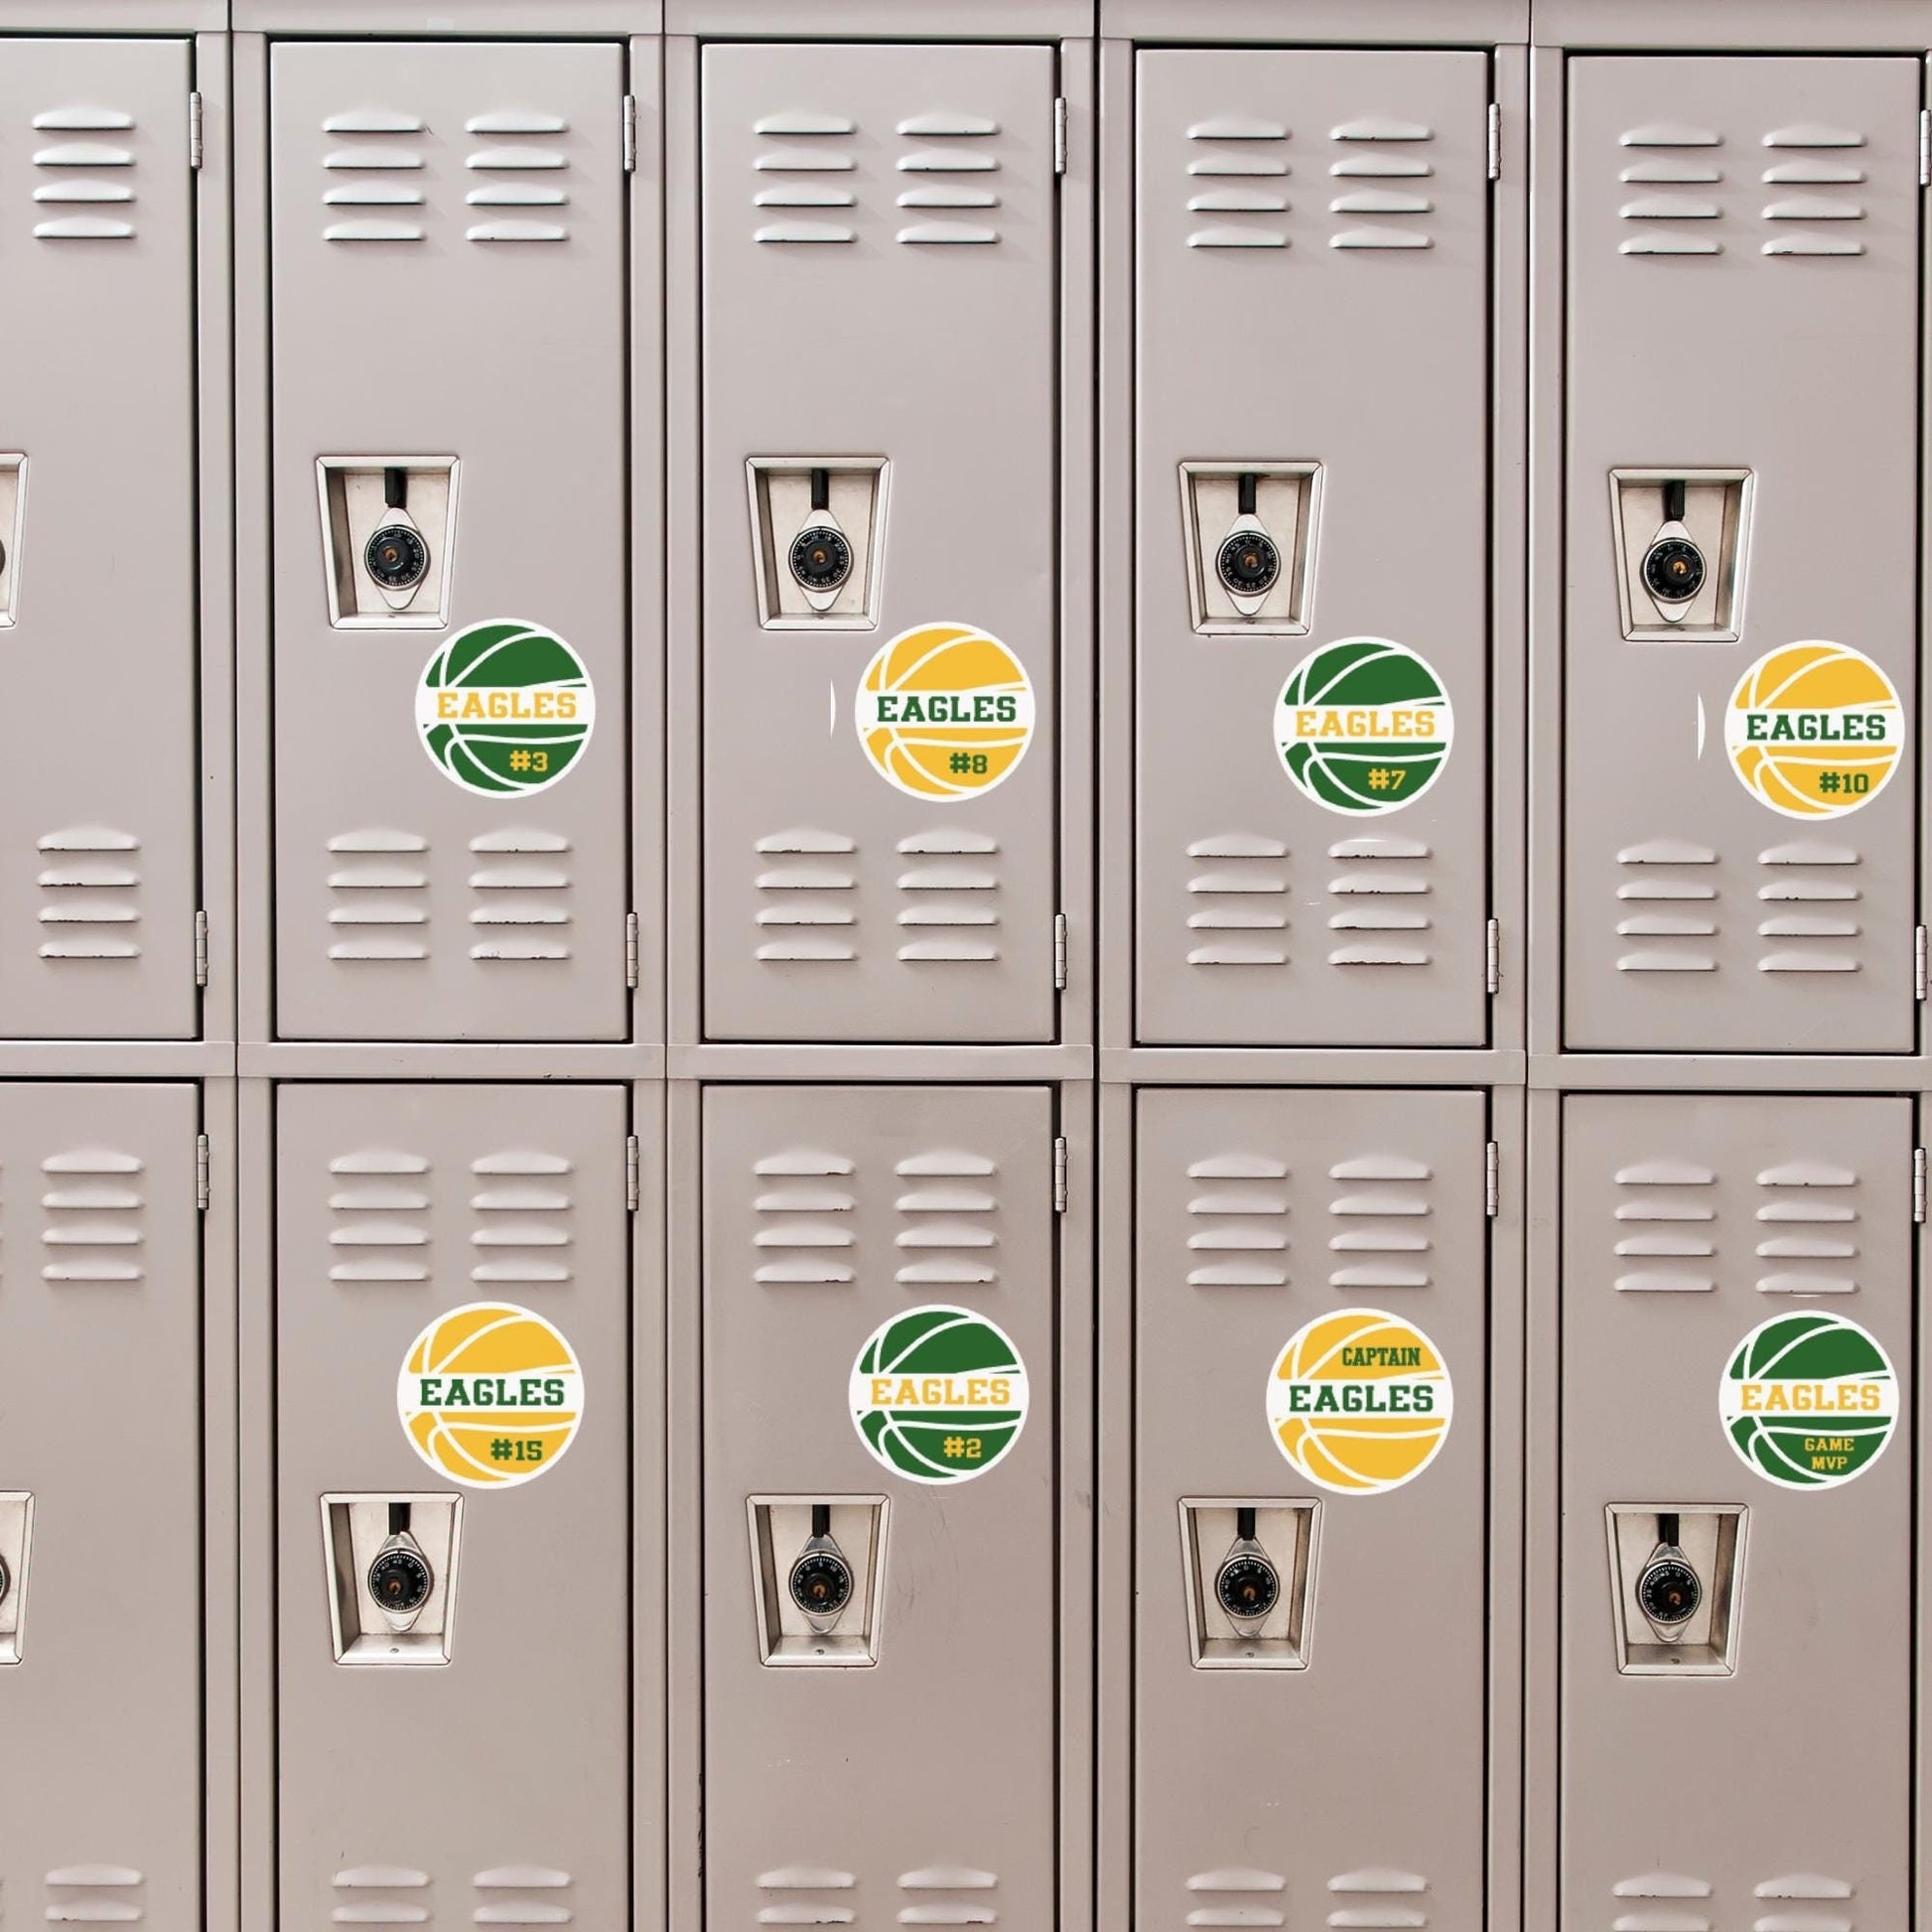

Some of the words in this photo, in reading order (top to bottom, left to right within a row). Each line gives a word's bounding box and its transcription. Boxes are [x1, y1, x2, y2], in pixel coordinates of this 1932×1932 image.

[438, 692, 576, 719] EAGLES
[878, 696, 1015, 722] EAGLES
[1297, 711, 1435, 737] EAGLES
[1747, 715, 1885, 740] EAGLES
[509, 750, 548, 771] #3
[949, 753, 988, 774] #8
[1368, 768, 1406, 790] #7
[1819, 771, 1868, 794] #10
[1342, 1347, 1422, 1366] CAPTAIN
[421, 1379, 565, 1406] EAGLES
[872, 1379, 1010, 1405] EAGLES
[1290, 1386, 1434, 1412] EAGLES
[1741, 1384, 1880, 1411] EAGLES
[490, 1439, 543, 1460] #15
[943, 1437, 982, 1458] #2
[1804, 1438, 1855, 1451] GAME
[1811, 1456, 1848, 1469] MVP
